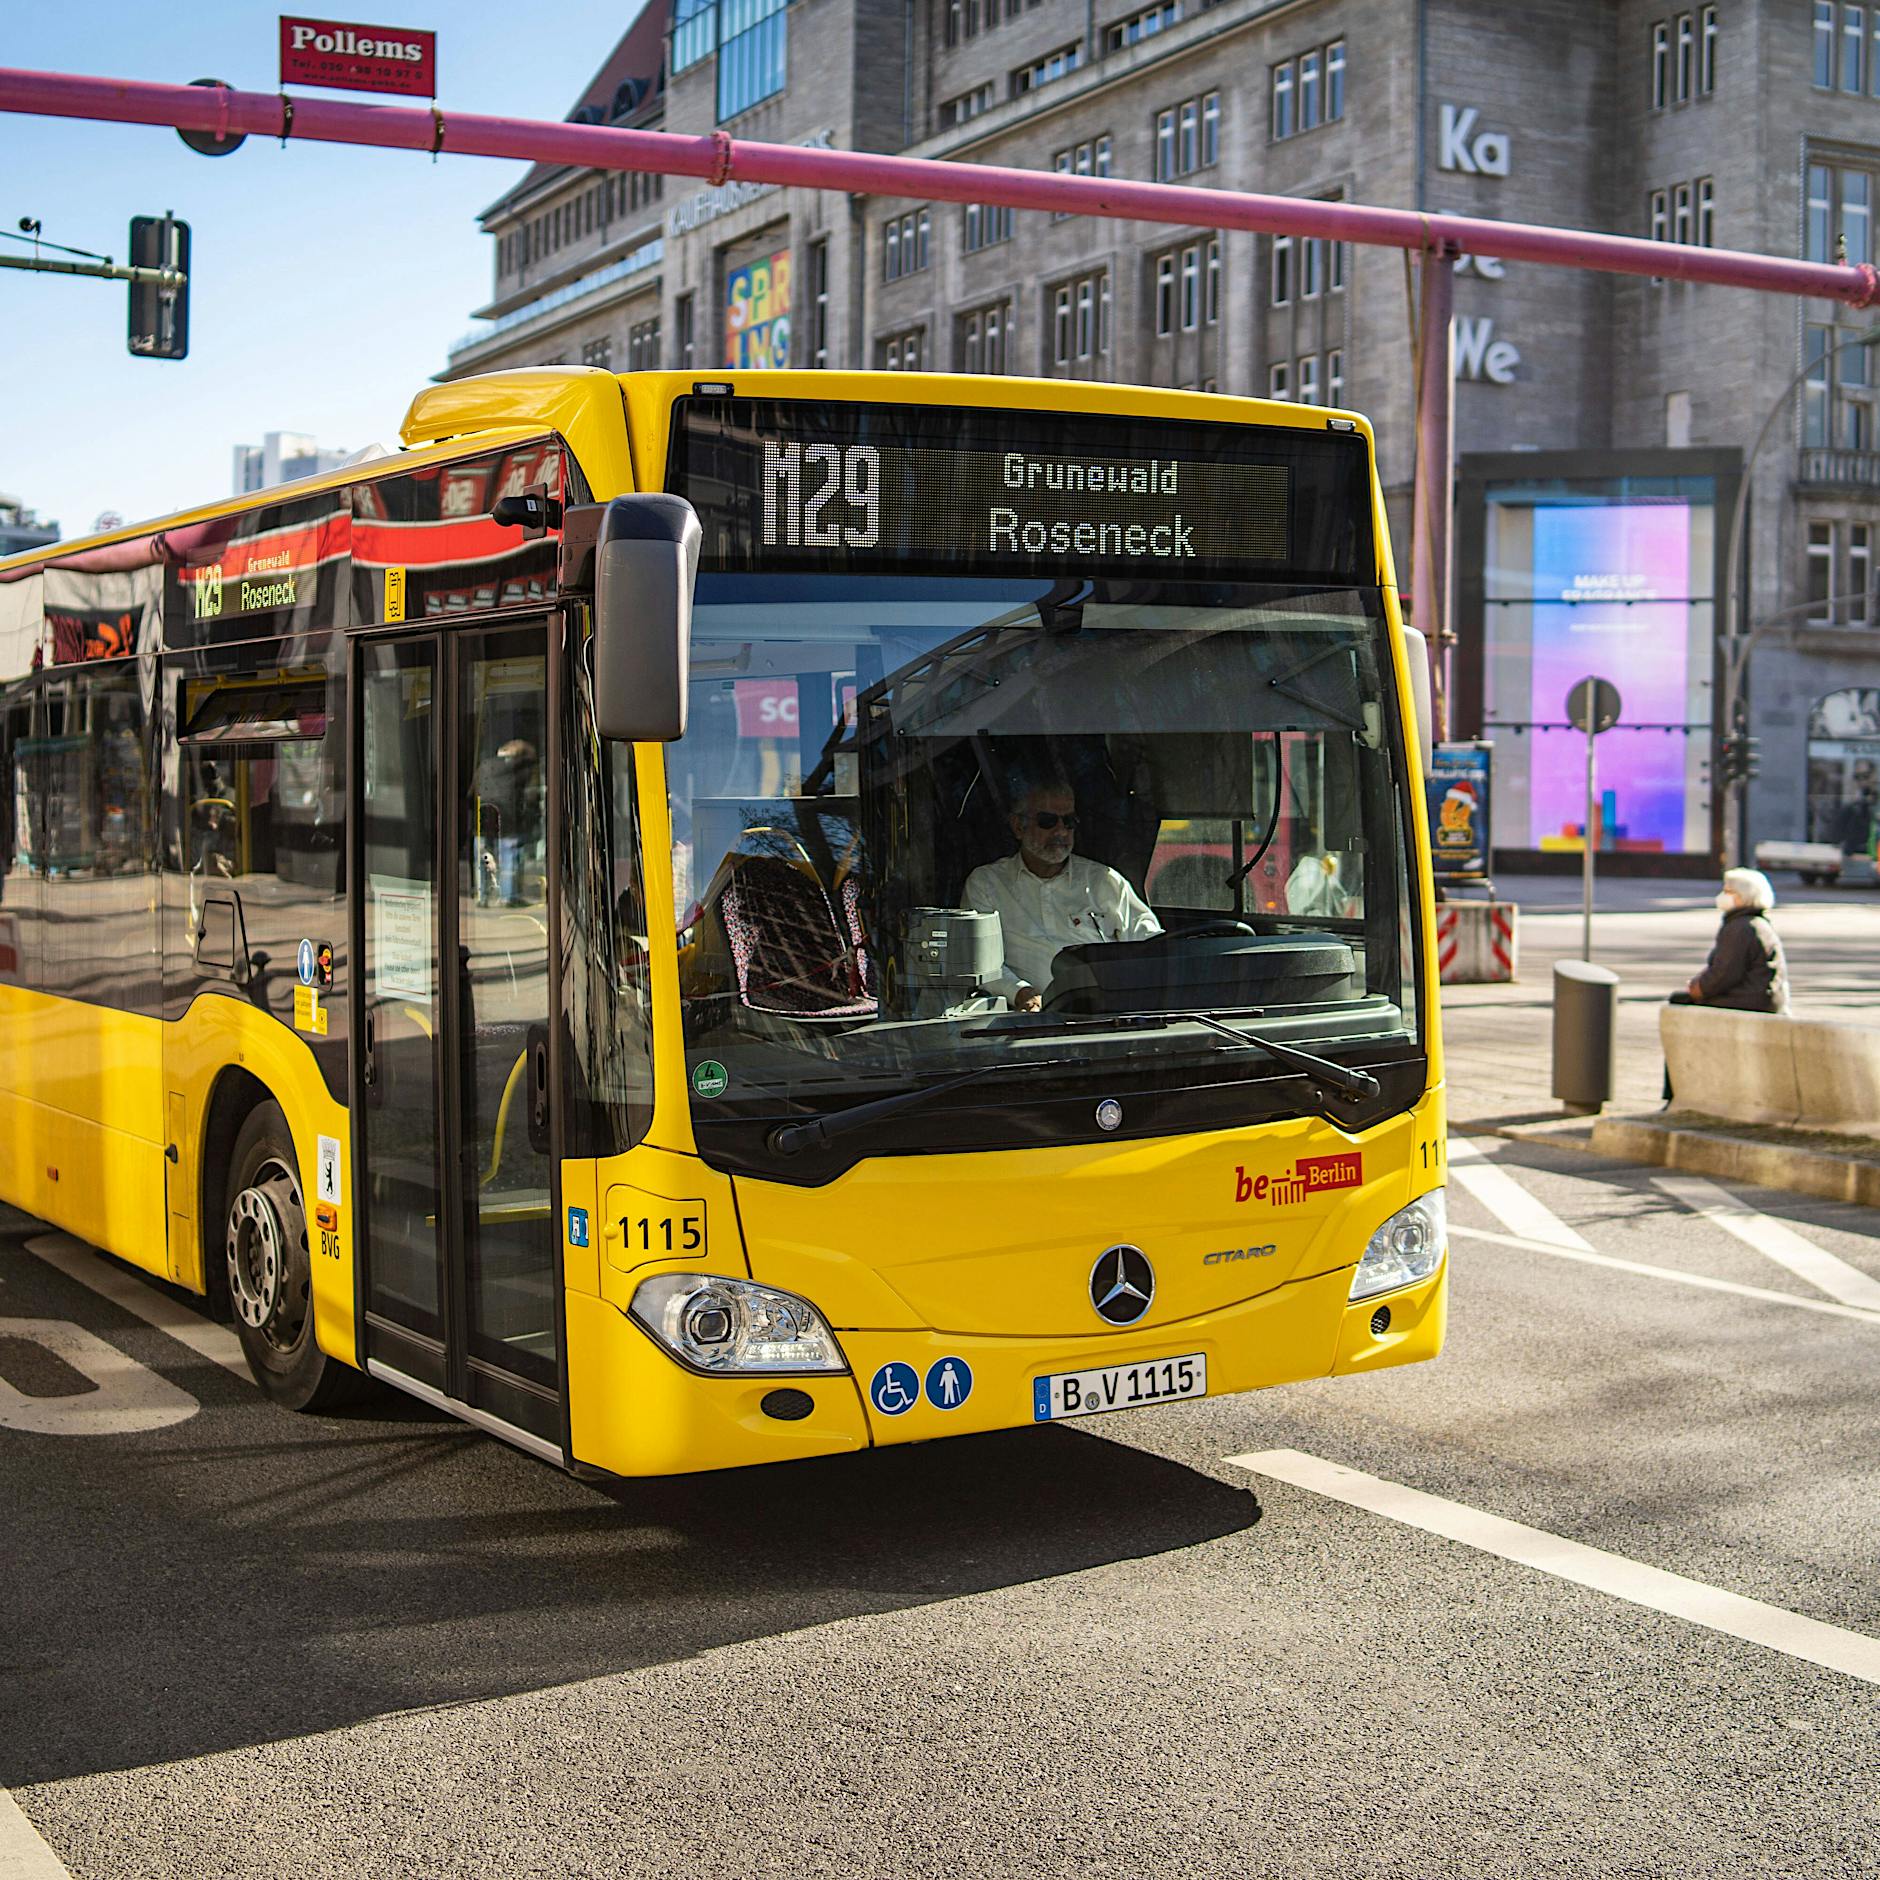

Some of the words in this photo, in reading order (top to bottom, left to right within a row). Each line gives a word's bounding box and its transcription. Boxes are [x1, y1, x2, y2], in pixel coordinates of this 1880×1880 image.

[290, 25, 422, 61] Pollems
[1440, 104, 1511, 176] Ka
[729, 258, 791, 328] SPR
[1455, 316, 1521, 384] We
[1004, 452, 1178, 494] Grunewald
[763, 440, 880, 547] M29
[990, 507, 1196, 558] Roseneck
[248, 549, 290, 573] Grunewald
[194, 563, 222, 619] M29
[241, 573, 296, 611] Roseneck
[1573, 574, 1620, 589] MAKE
[1235, 1166, 1269, 1203] be
[1308, 1162, 1356, 1186] Berlin
[321, 1231, 340, 1260] BVG
[618, 1216, 701, 1250] 1115
[1203, 1244, 1277, 1266] CITARO
[1063, 1378, 1081, 1411] B
[1102, 1372, 1119, 1405] V
[1127, 1360, 1193, 1402] 1115
[1039, 1403, 1047, 1414] D
